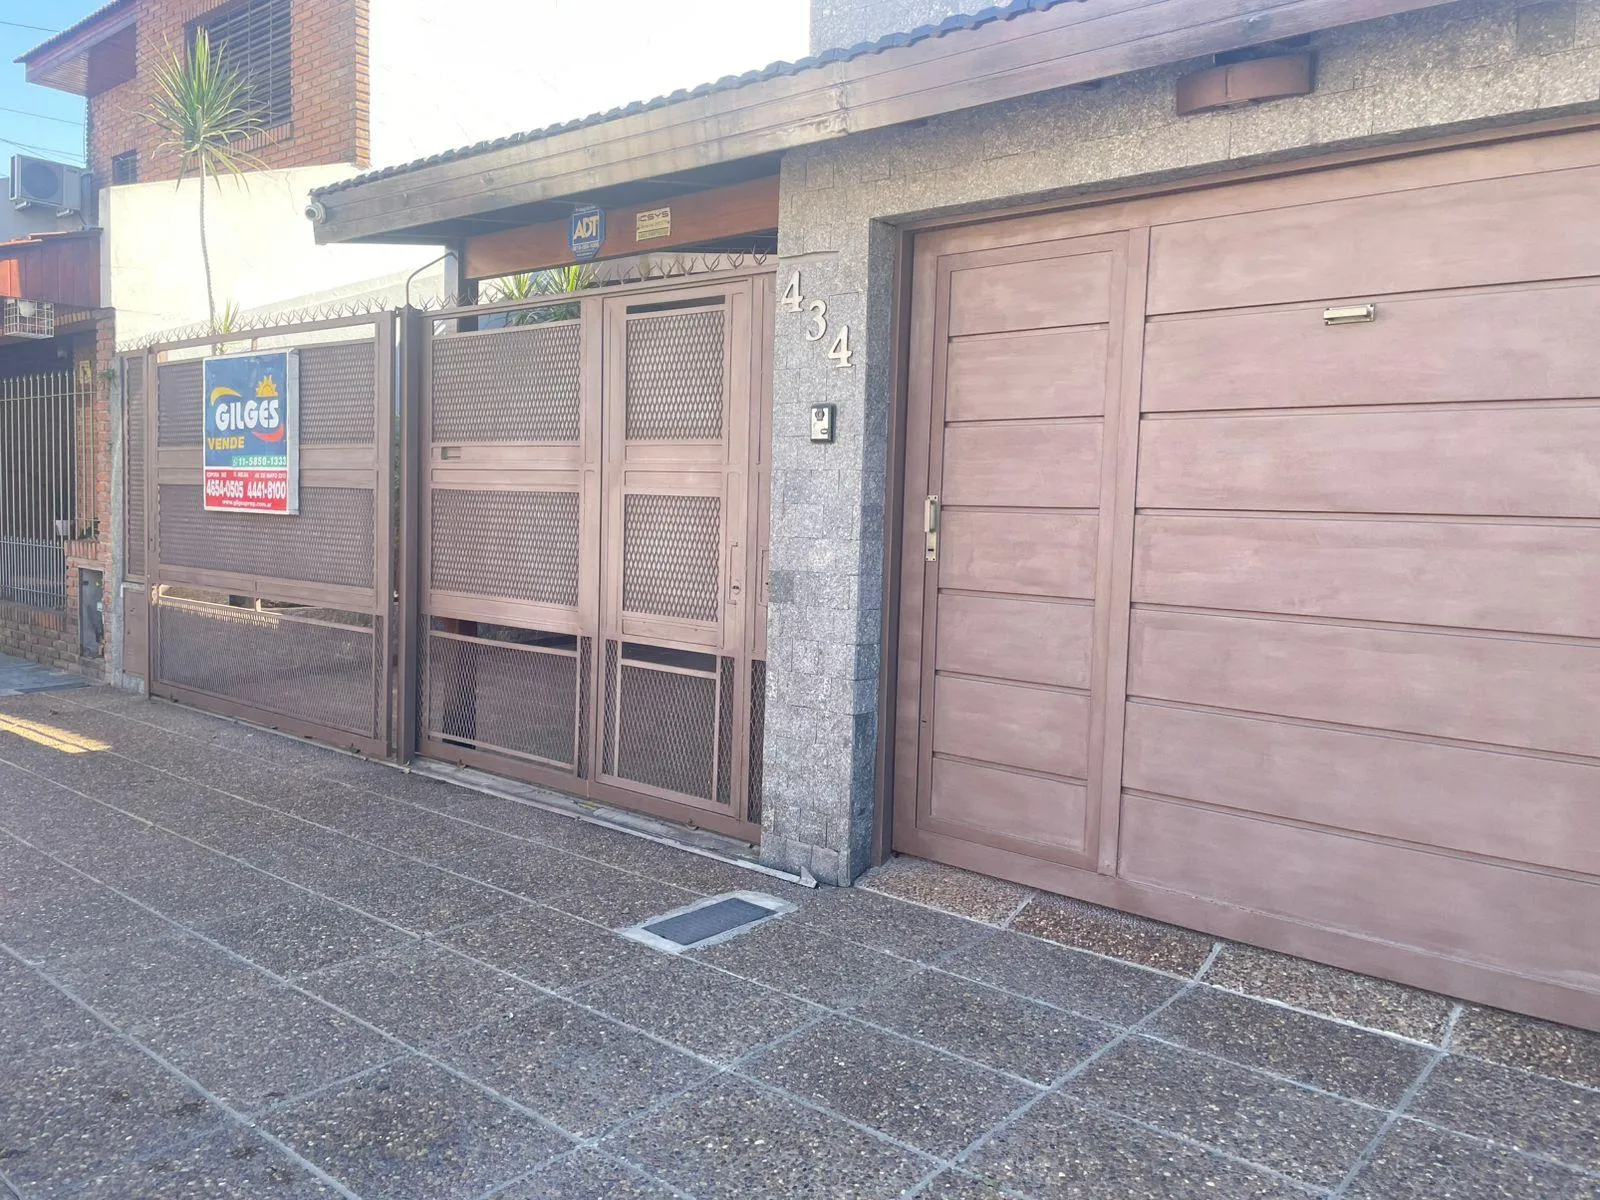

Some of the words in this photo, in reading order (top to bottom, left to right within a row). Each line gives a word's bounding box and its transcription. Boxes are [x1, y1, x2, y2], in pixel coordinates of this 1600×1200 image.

[573, 215, 599, 240] ADT
[781, 270, 853, 368] 434
[215, 400, 279, 431] GILGES
[208, 436, 245, 450] VENDE
[238, 455, 287, 466] 11-5850-1333
[206, 479, 244, 498] 4654-0505
[247, 480, 286, 500] 4441-8100
